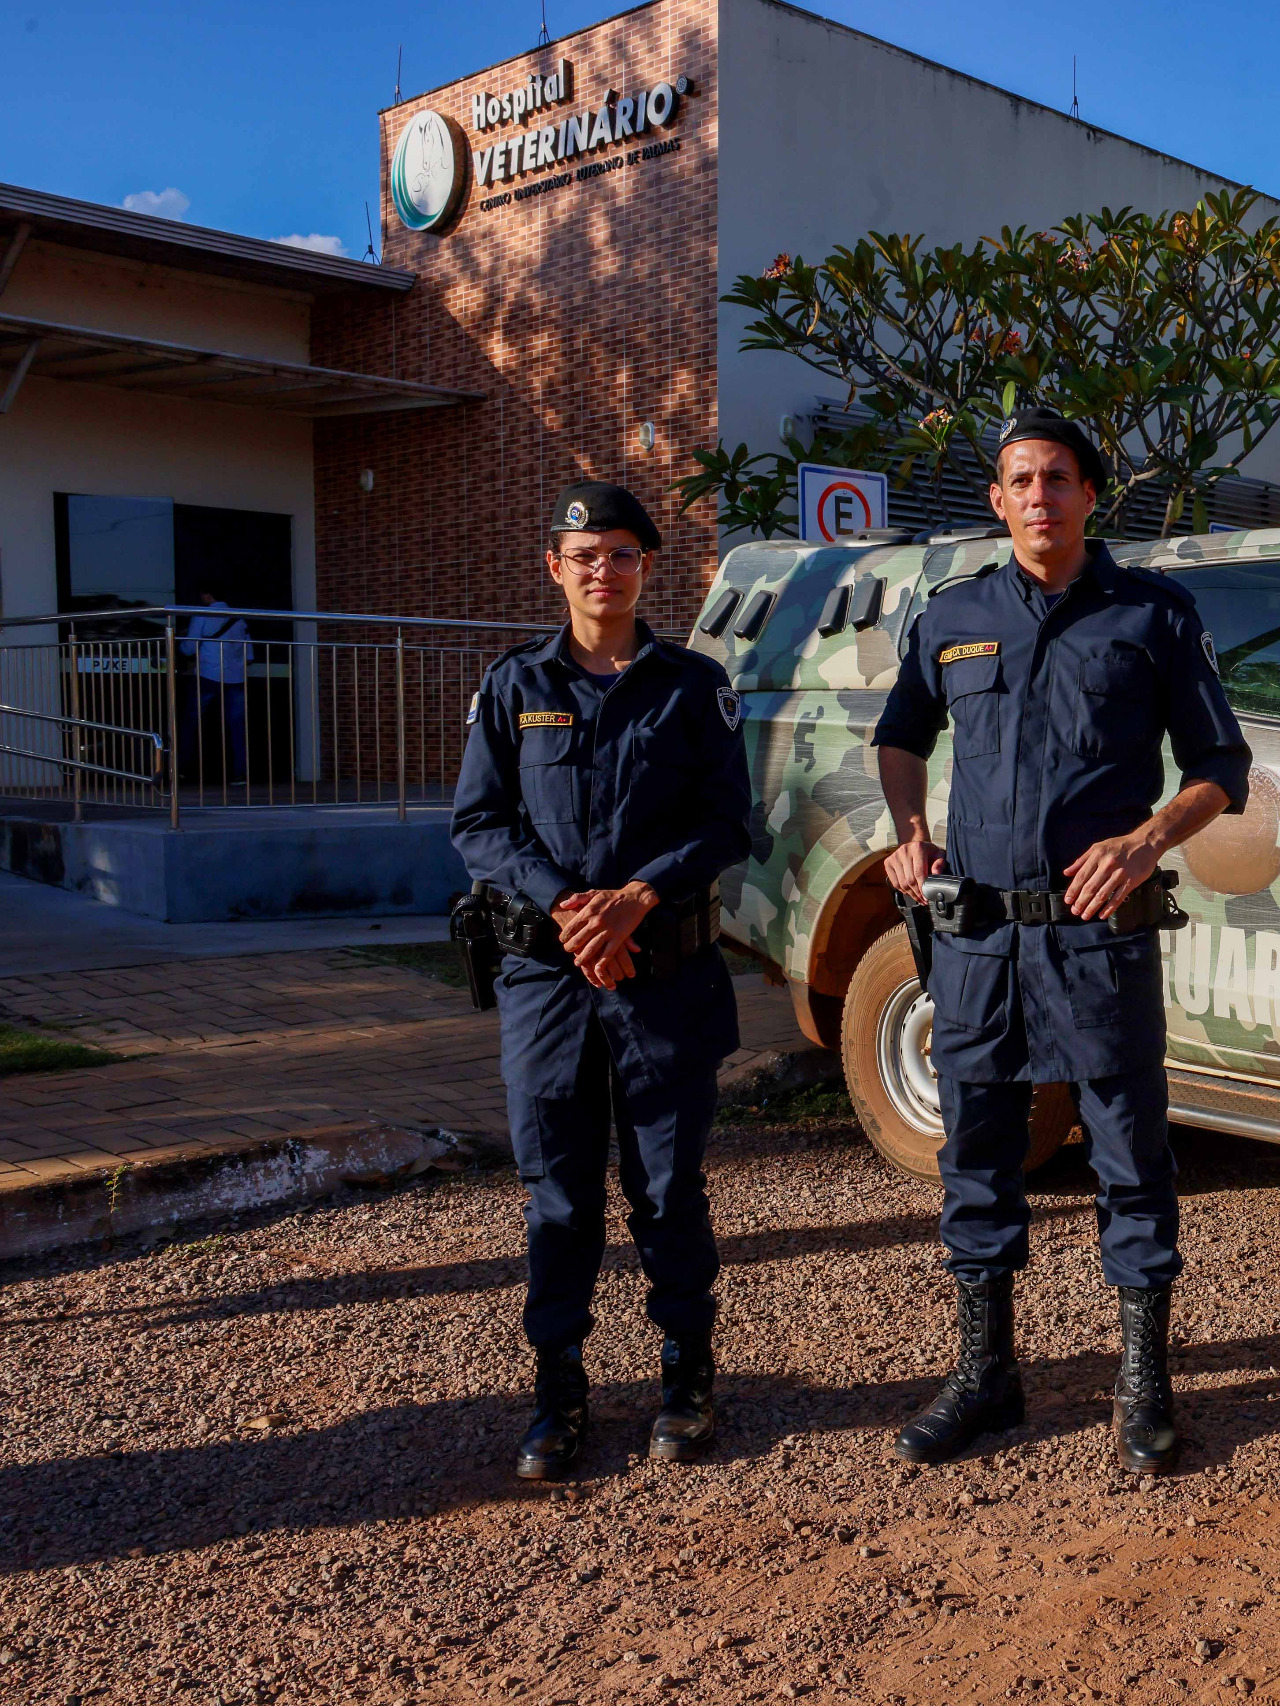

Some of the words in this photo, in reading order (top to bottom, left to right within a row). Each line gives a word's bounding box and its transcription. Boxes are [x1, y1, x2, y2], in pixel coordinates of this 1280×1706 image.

[472, 59, 565, 130] Hospital
[473, 82, 672, 186] VETERINÁRIO
[480, 192, 511, 212] CENTRO
[576, 156, 624, 182] LUTERANO
[627, 151, 640, 165] DE
[642, 137, 681, 160] PALMAS
[835, 496, 853, 534] E
[93, 660, 127, 671] PUXE
[962, 645, 985, 655] DUQUE
[528, 714, 555, 723] KUSTER
